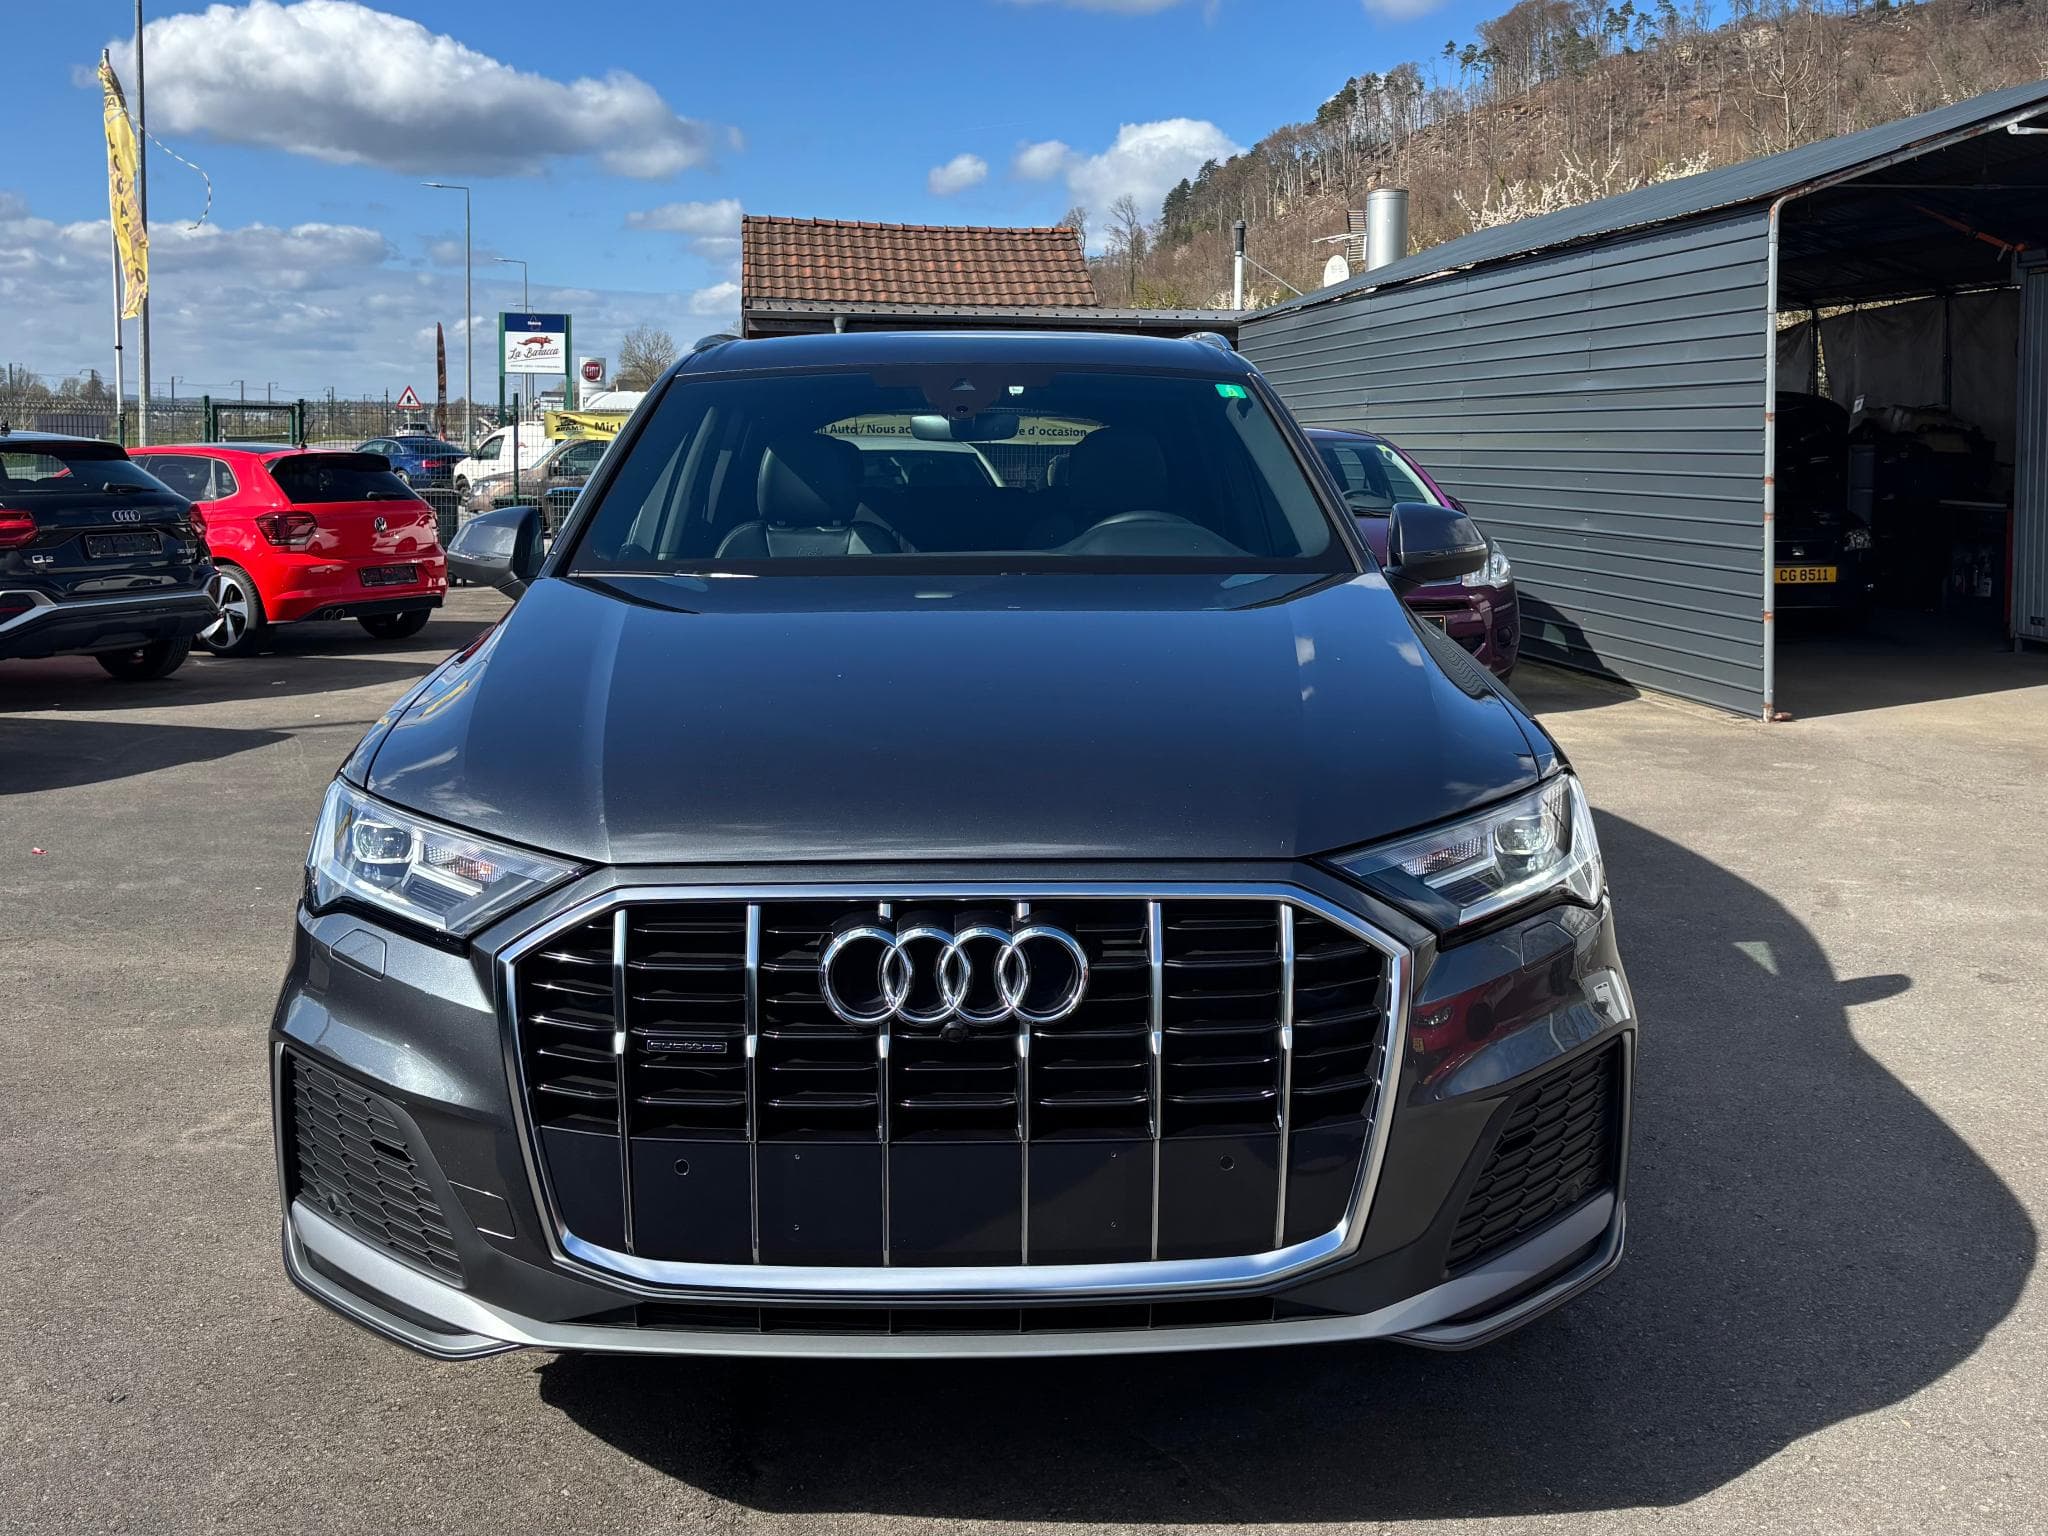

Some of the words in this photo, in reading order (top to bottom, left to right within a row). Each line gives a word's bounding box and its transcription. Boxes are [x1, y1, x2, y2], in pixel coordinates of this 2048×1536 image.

[594, 422, 615, 432] Mir
[829, 424, 858, 434] Auto
[866, 424, 896, 434] Nous
[1780, 569, 1797, 581] CG
[1800, 569, 1829, 581] 8511
